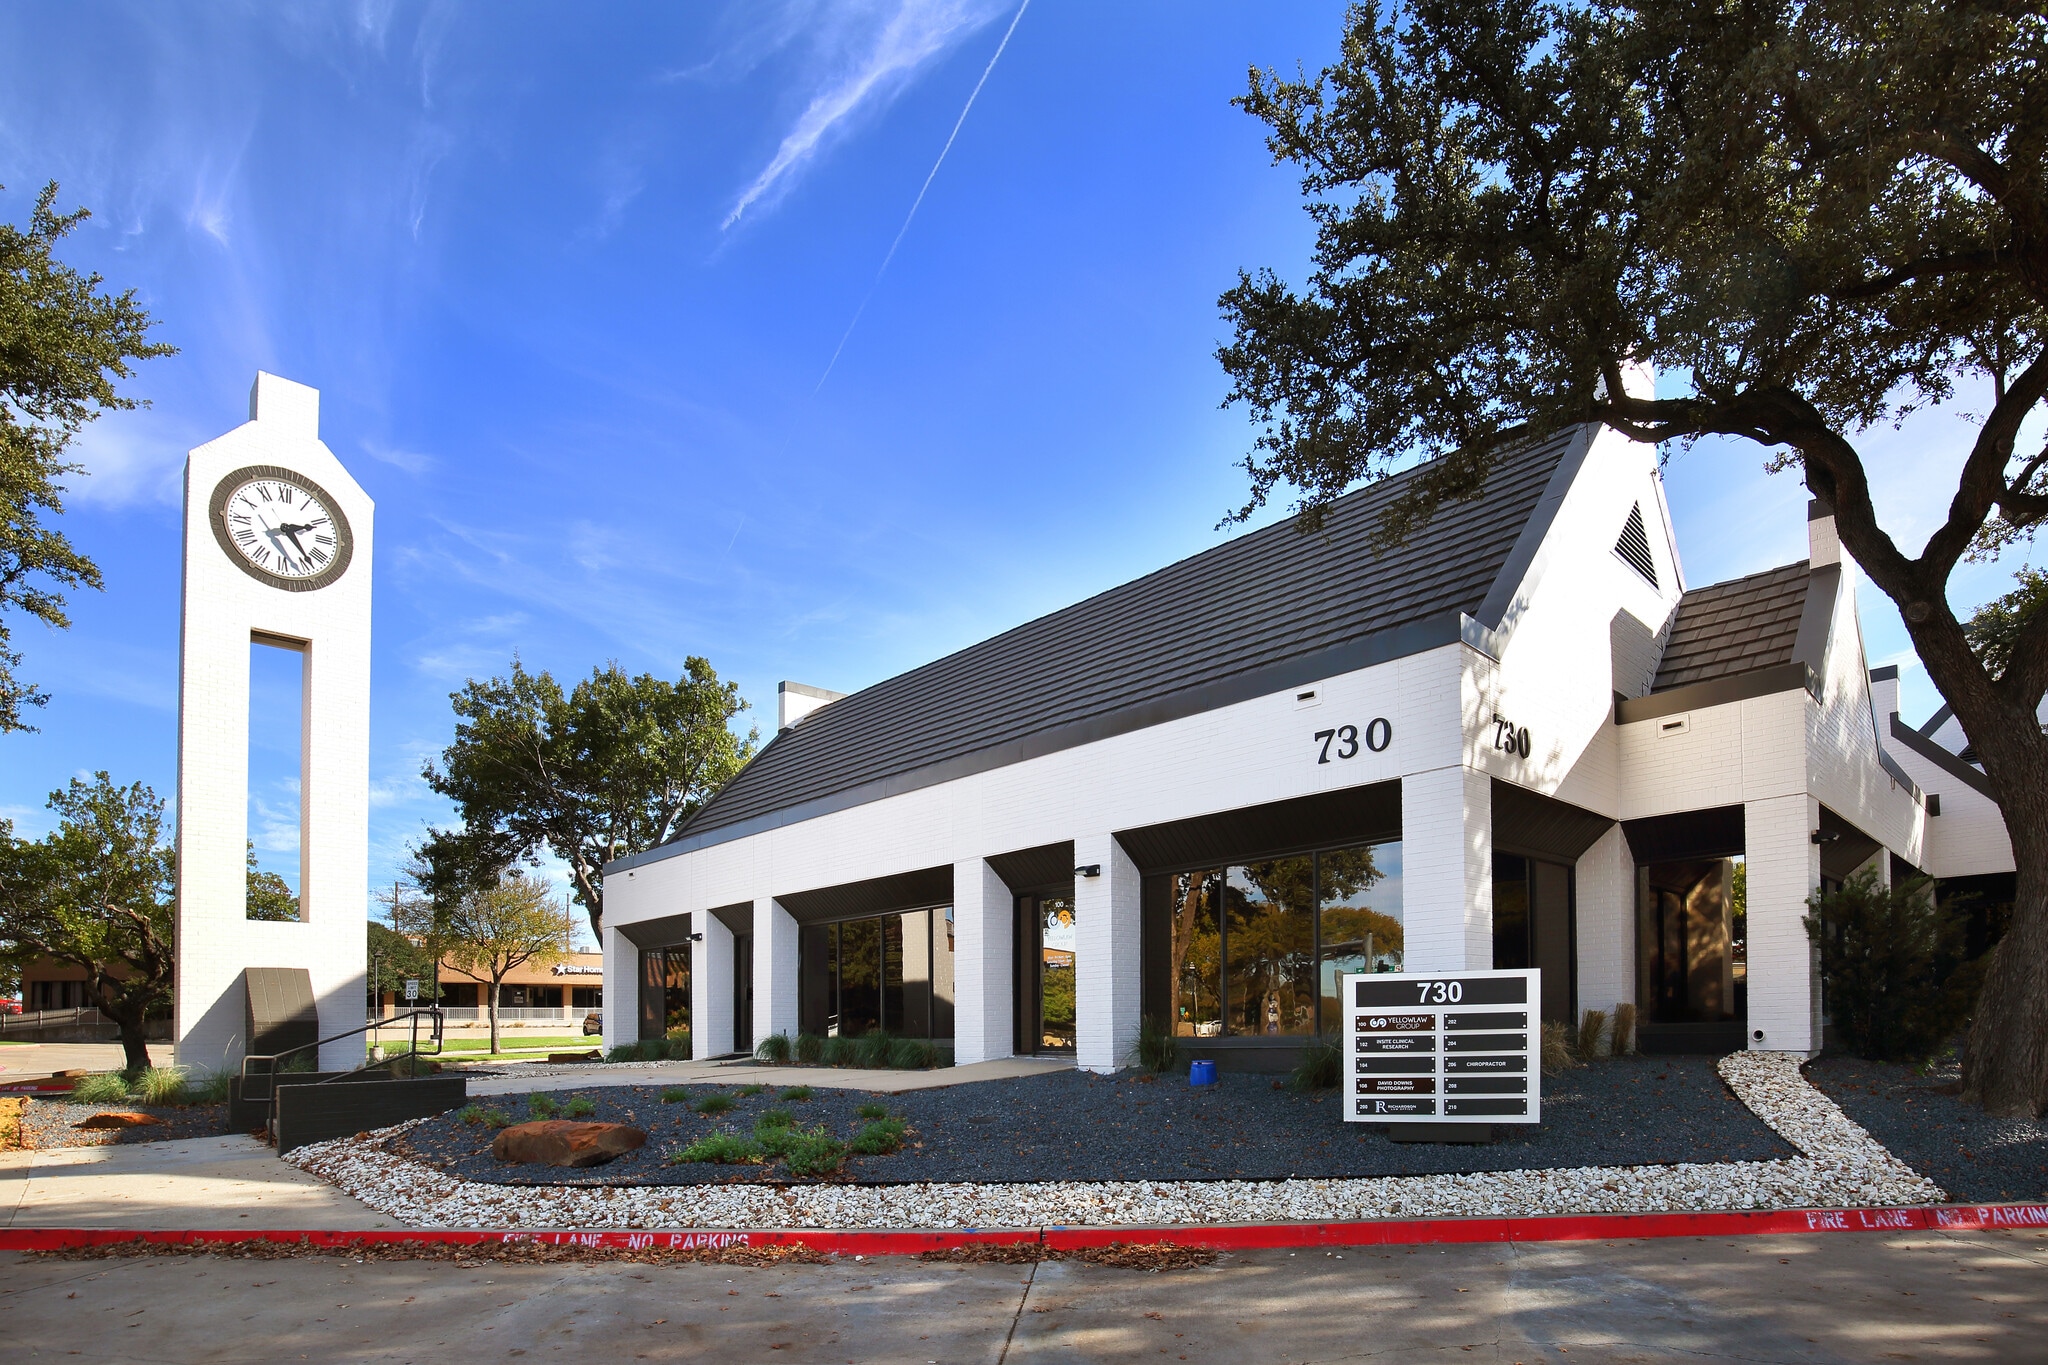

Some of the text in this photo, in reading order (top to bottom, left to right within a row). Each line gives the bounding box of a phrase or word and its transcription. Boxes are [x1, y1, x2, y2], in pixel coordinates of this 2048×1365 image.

[278, 485, 292, 504] XII
[1314, 717, 1392, 765] 730
[1492, 712, 1531, 760] 730
[567, 965, 604, 973] Star Hom
[406, 990, 417, 998] 30
[1416, 981, 1463, 1004] 730
[1387, 1016, 1428, 1024] YELLOWLAW
[1806, 1211, 1849, 1230] FIRE
[1859, 1209, 1913, 1228] LANE
[1936, 1209, 1963, 1226] NO
[628, 1233, 654, 1250] NO
